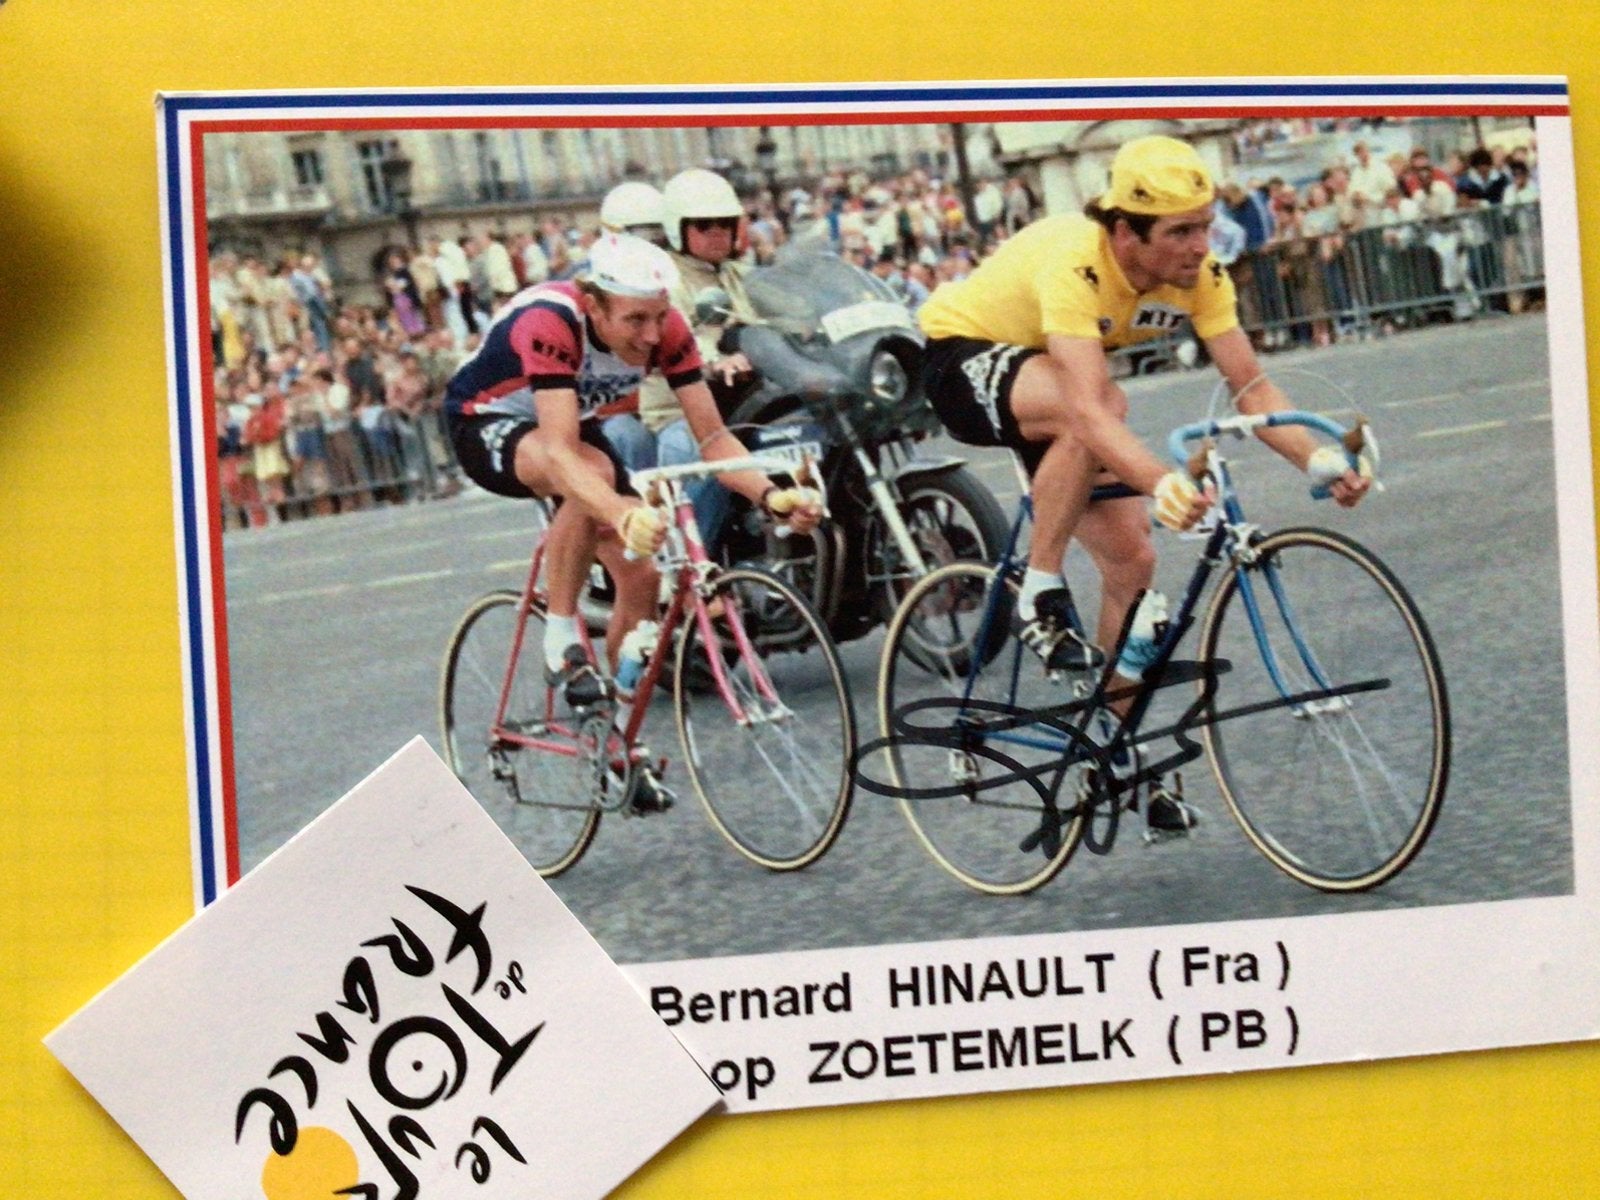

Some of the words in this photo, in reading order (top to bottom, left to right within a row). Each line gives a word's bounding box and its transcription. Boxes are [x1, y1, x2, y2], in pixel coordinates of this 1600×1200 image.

[494, 960, 527, 1000] de
[651, 973, 852, 1027] Bernard
[889, 953, 1115, 1008] HINAULT
[710, 1056, 776, 1100] op
[808, 1019, 1135, 1084] ZOETEMELK
